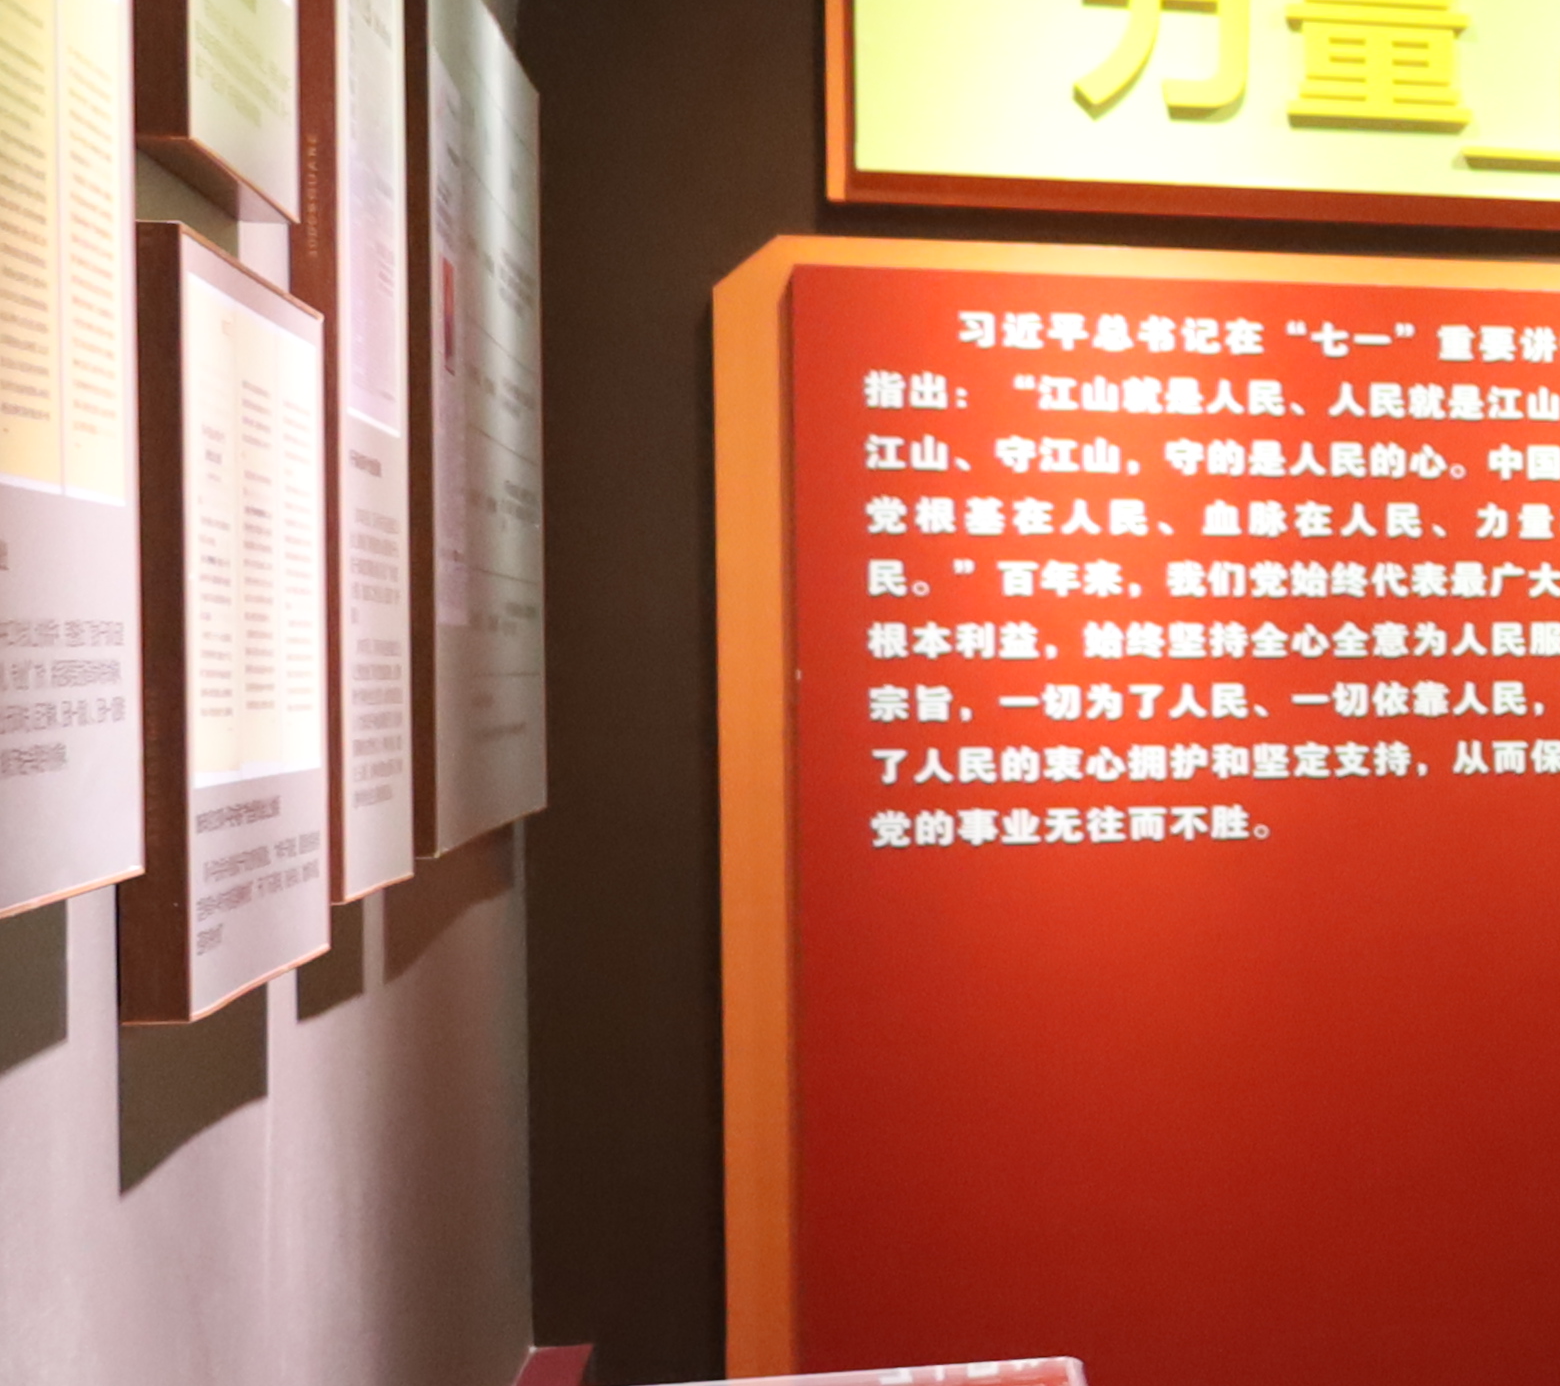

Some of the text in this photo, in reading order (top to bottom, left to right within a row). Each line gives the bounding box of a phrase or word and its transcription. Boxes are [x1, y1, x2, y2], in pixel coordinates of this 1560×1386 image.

[870, 804, 1270, 847] 党的事业无往而不胜。
